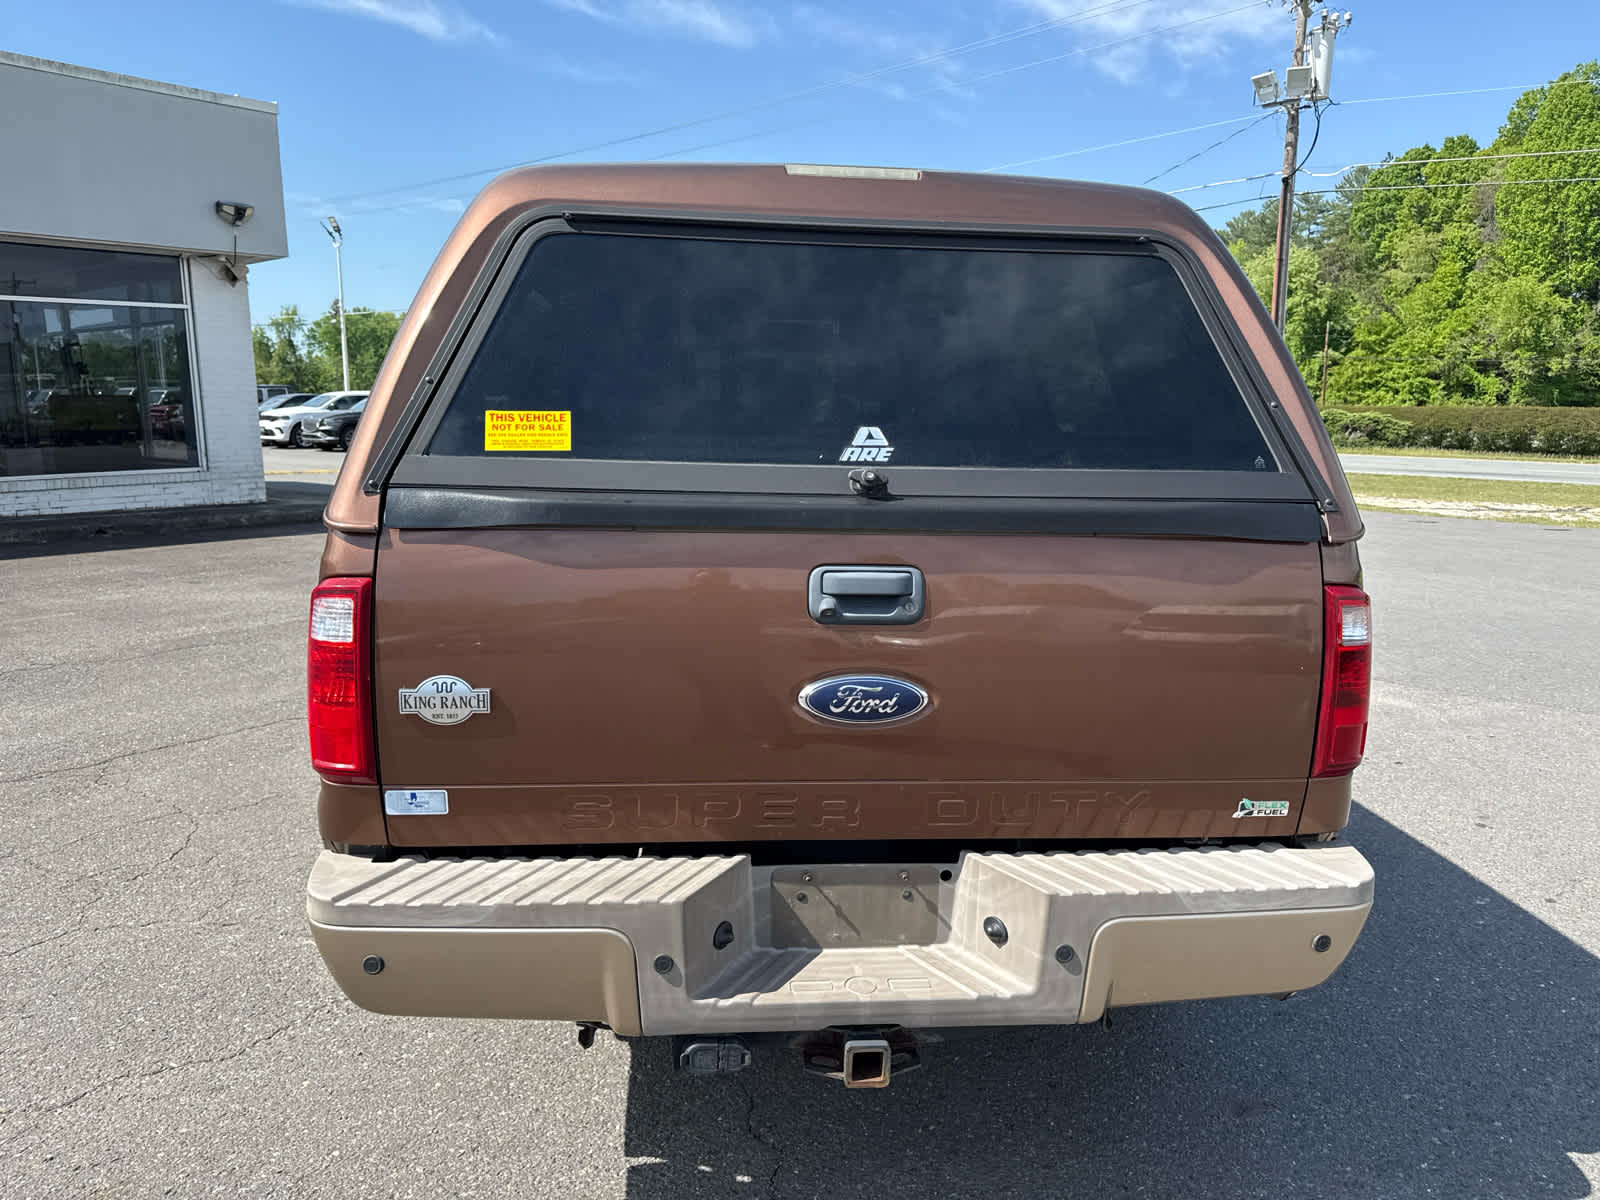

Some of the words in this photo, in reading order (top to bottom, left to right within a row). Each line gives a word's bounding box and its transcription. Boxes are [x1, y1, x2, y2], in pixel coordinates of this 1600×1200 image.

[489, 412, 515, 422] THIS
[518, 412, 567, 422] VEHICLE
[491, 423, 512, 431] NOT
[515, 423, 535, 431] FOR
[539, 423, 564, 431] SALE
[839, 447, 895, 462] ARE
[403, 694, 437, 710] KING
[440, 693, 486, 709] RANCH
[829, 684, 900, 713] Ford
[566, 792, 862, 831] SUPER
[928, 790, 1150, 826] DUTY
